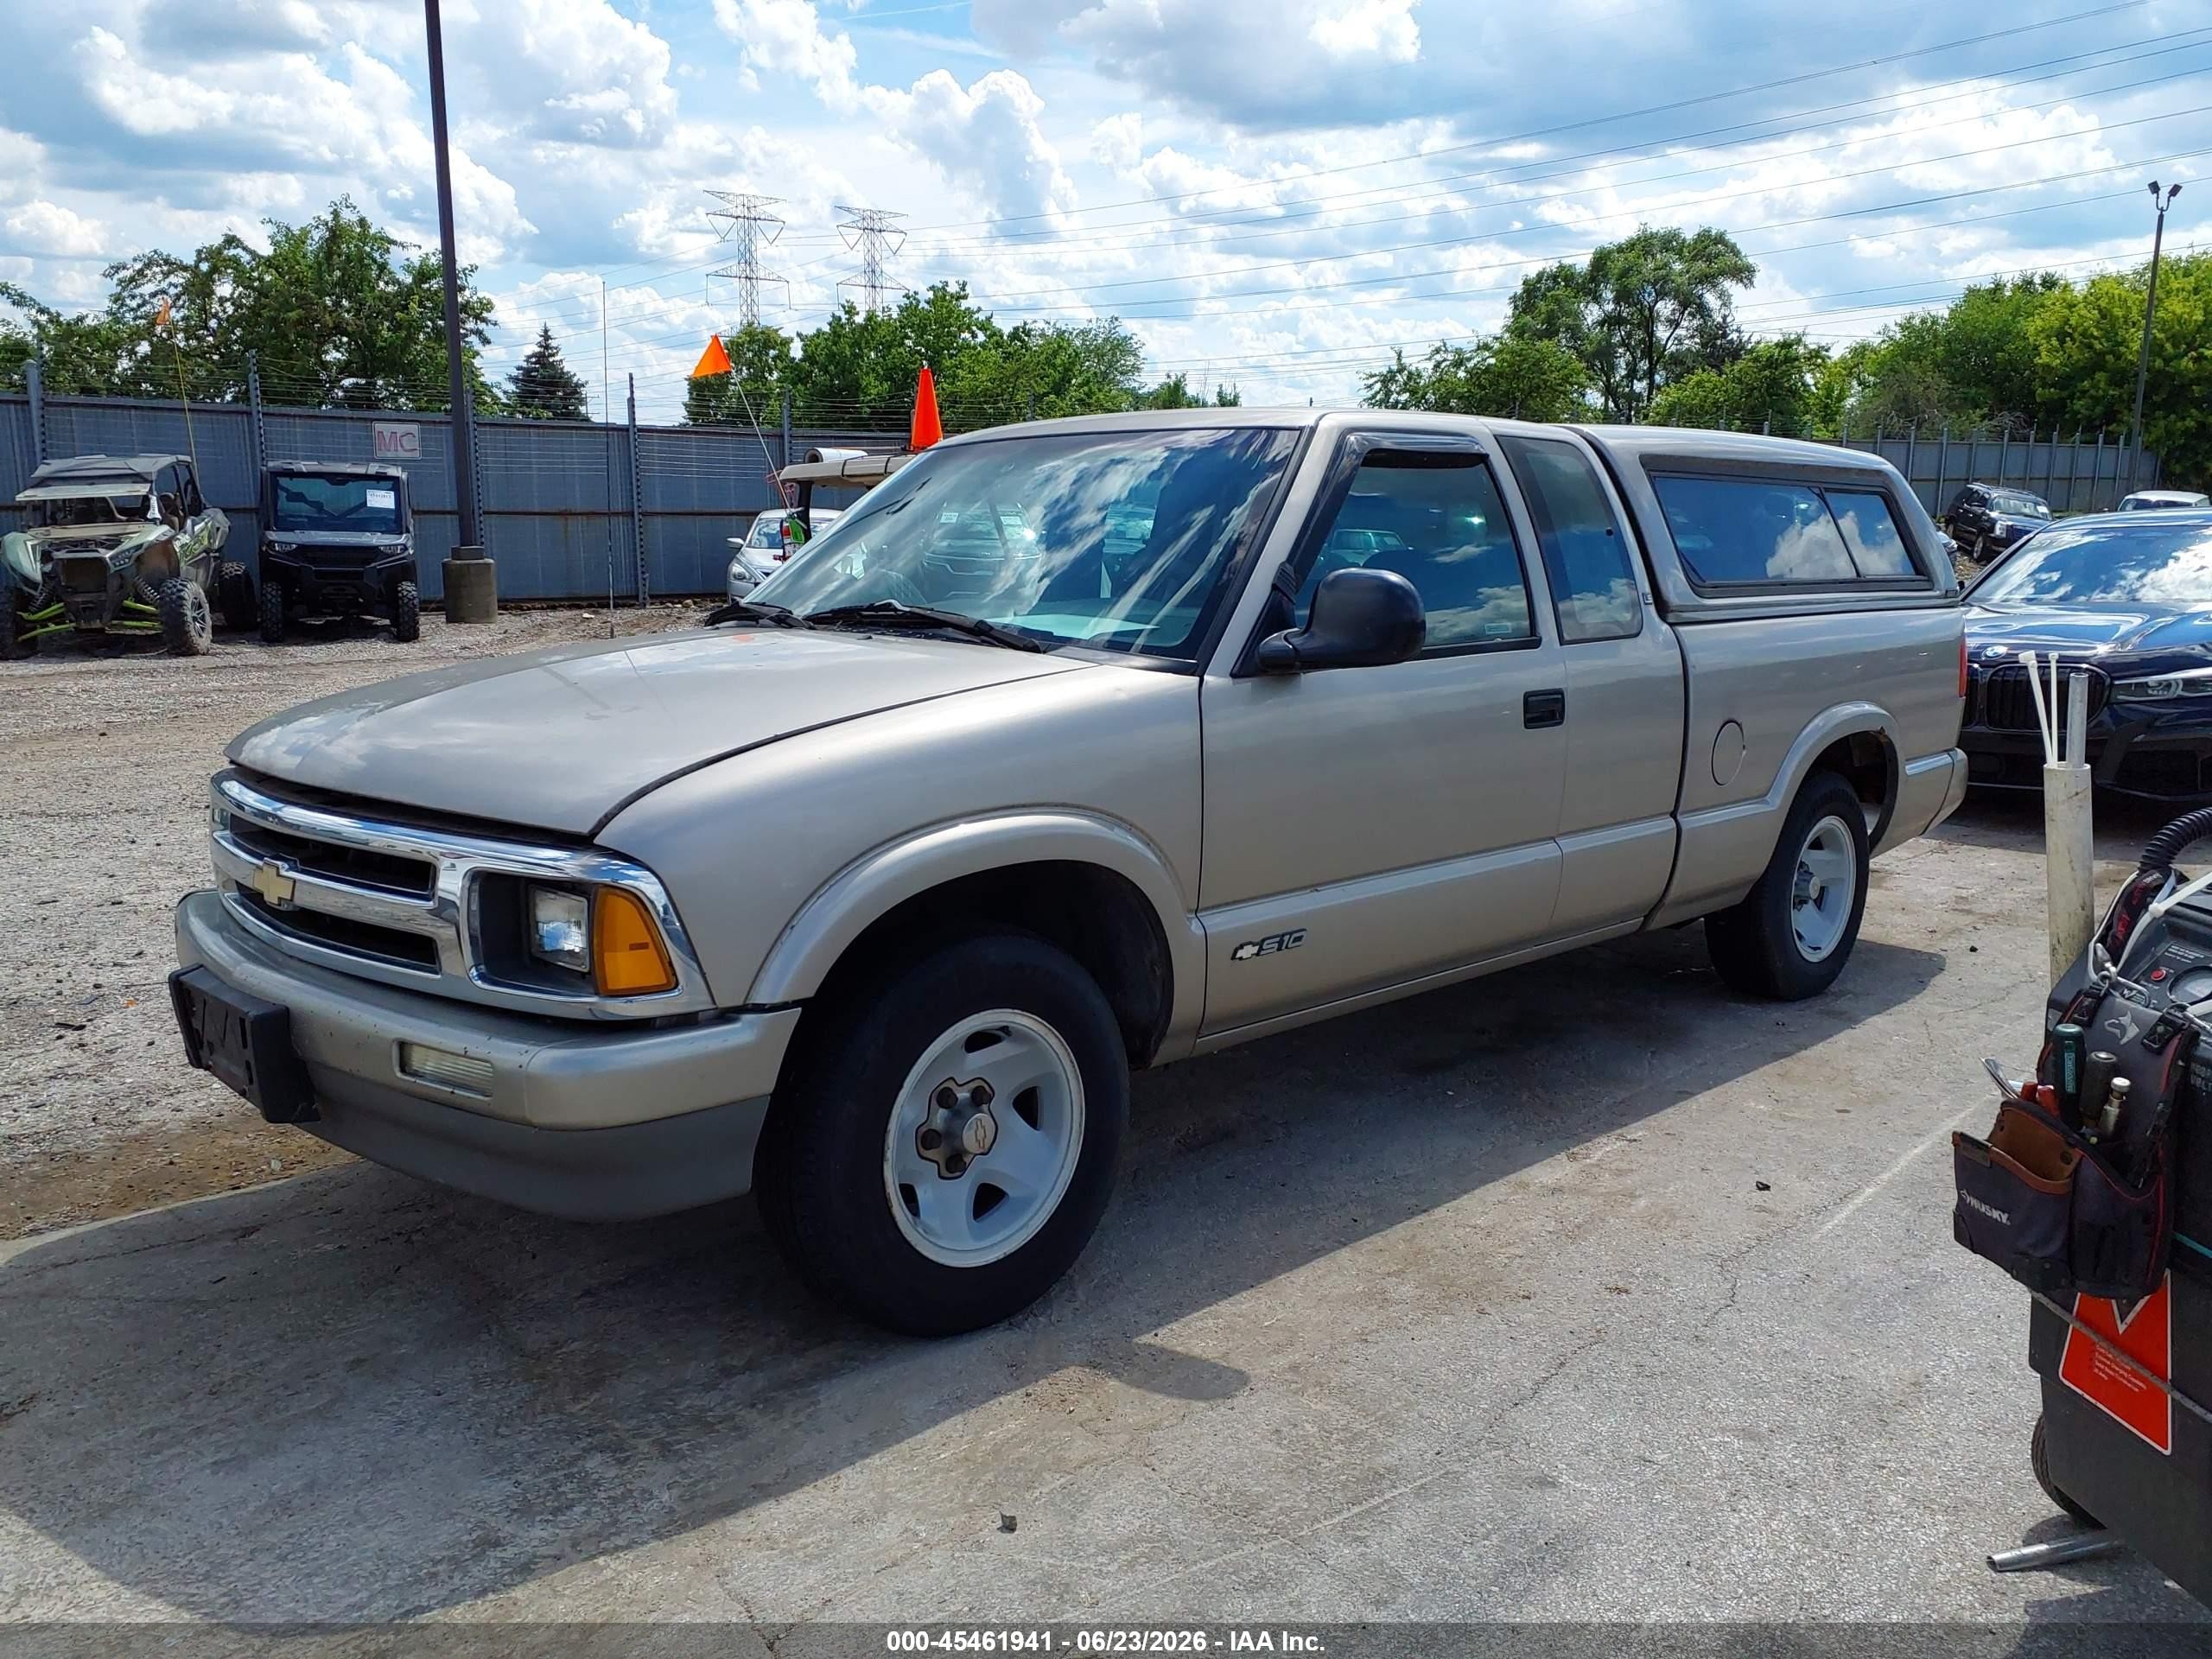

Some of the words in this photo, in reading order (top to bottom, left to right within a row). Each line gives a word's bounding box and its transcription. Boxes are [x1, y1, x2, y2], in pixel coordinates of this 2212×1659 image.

[377, 430, 418, 453] MC
[1259, 930, 1306, 956] S10
[1970, 1196, 2009, 1224] HUSKY
